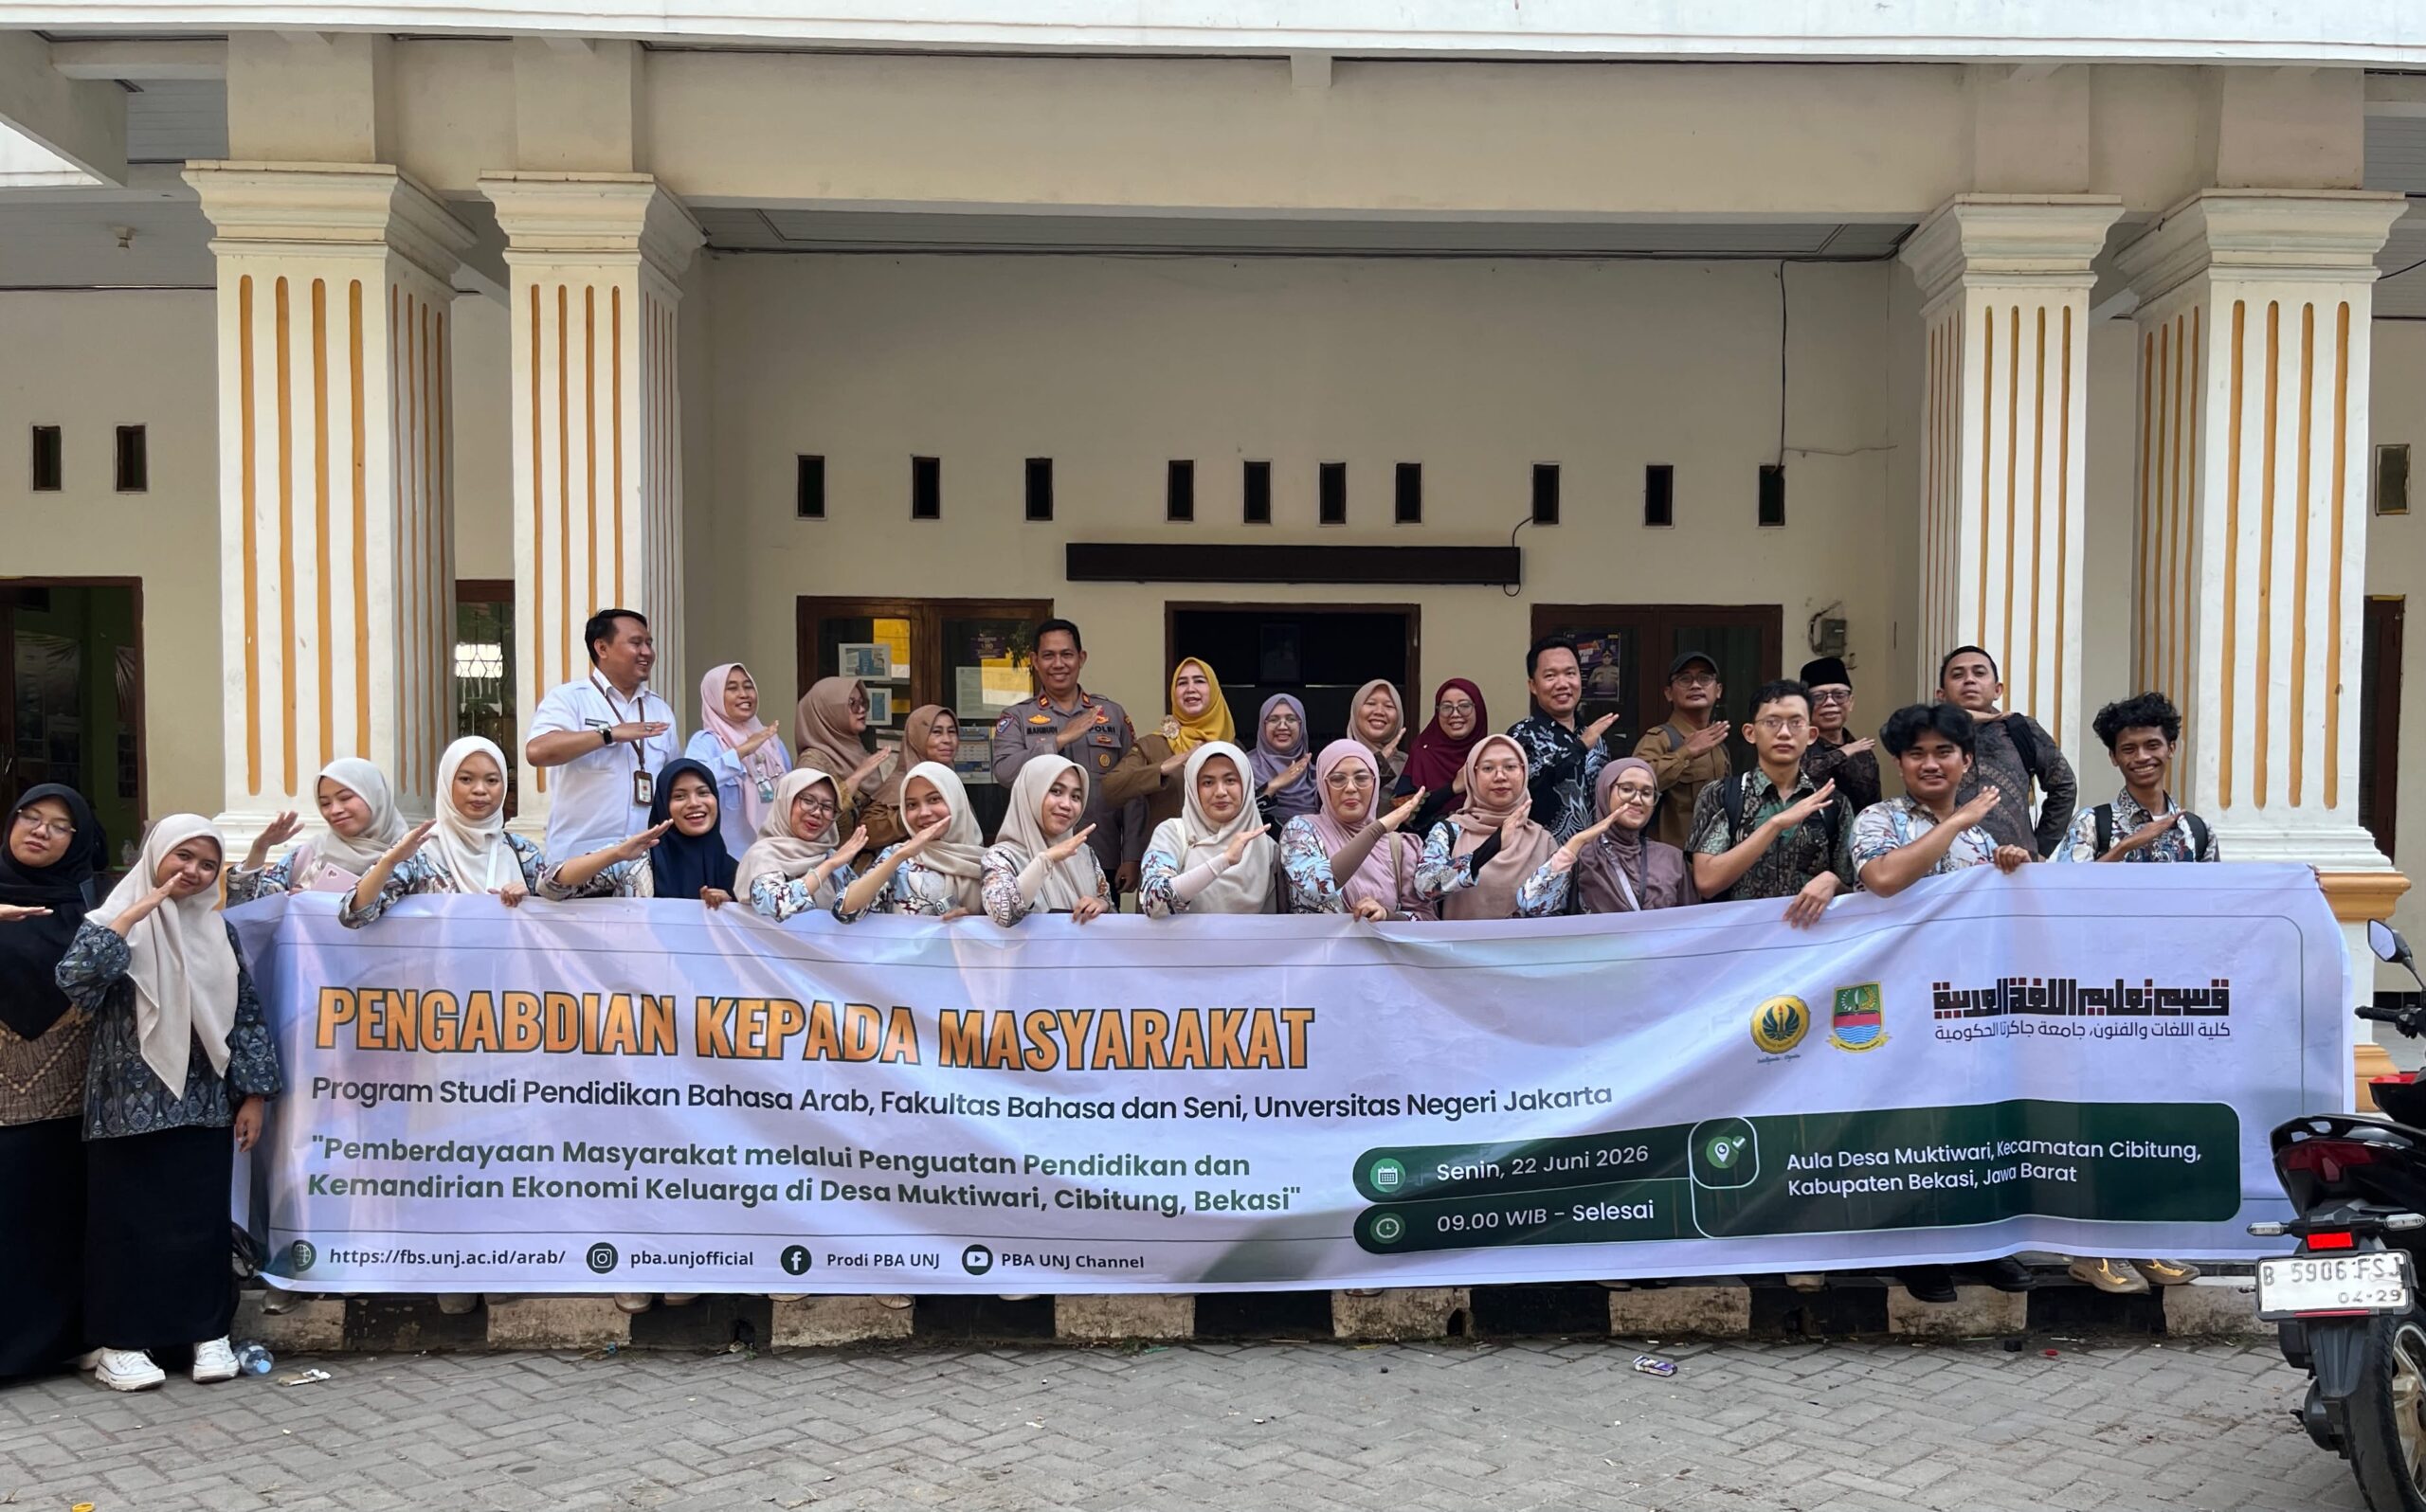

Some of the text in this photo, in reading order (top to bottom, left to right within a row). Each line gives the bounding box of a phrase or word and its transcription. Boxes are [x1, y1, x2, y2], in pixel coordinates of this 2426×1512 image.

[315, 985, 1315, 1071] PENGABDIAN KEPADA MASYARAKAT
[2037, 1022, 2085, 1039] جامعة
[2151, 1021, 2194, 1036] اللغات
[2198, 1022, 2231, 1039] كلية
[312, 1076, 1612, 1123] Program Studi Pendidikan Bahasa Arab, Fakultas Bahasa dan Seni, Unversitas Negeri Jakarta
[312, 1134, 1250, 1179] "Pemberdayaan Masyarakat melalui Penguatan Pendidikan dan
[1437, 1144, 1649, 1181] Senin, 22 Juni 2026
[1786, 1140, 2201, 1171] Aula Desa Muktiwari, Kecamatan Cibitung,
[1788, 1162, 2077, 1198] Kabupaten Bekasi, Jawa Barat
[308, 1174, 1301, 1219] Kemandirian Ekonomi Keluarga di Desa Muktiwari, Cibitung, Bekasi"
[1437, 1212, 1499, 1233] 09.00
[1505, 1208, 1548, 1226] WIB
[1572, 1198, 1654, 1222] Selesai
[329, 1248, 566, 1269] https://fbs.unj.ac.id/arab/
[630, 1250, 753, 1269] pba.unjofficial
[827, 1253, 940, 1270] Prodi PBA UNJ
[1002, 1252, 1145, 1270] PBA UNJ Channel
[2263, 1266, 2274, 1286] B
[2290, 1261, 2346, 1283] 5906
